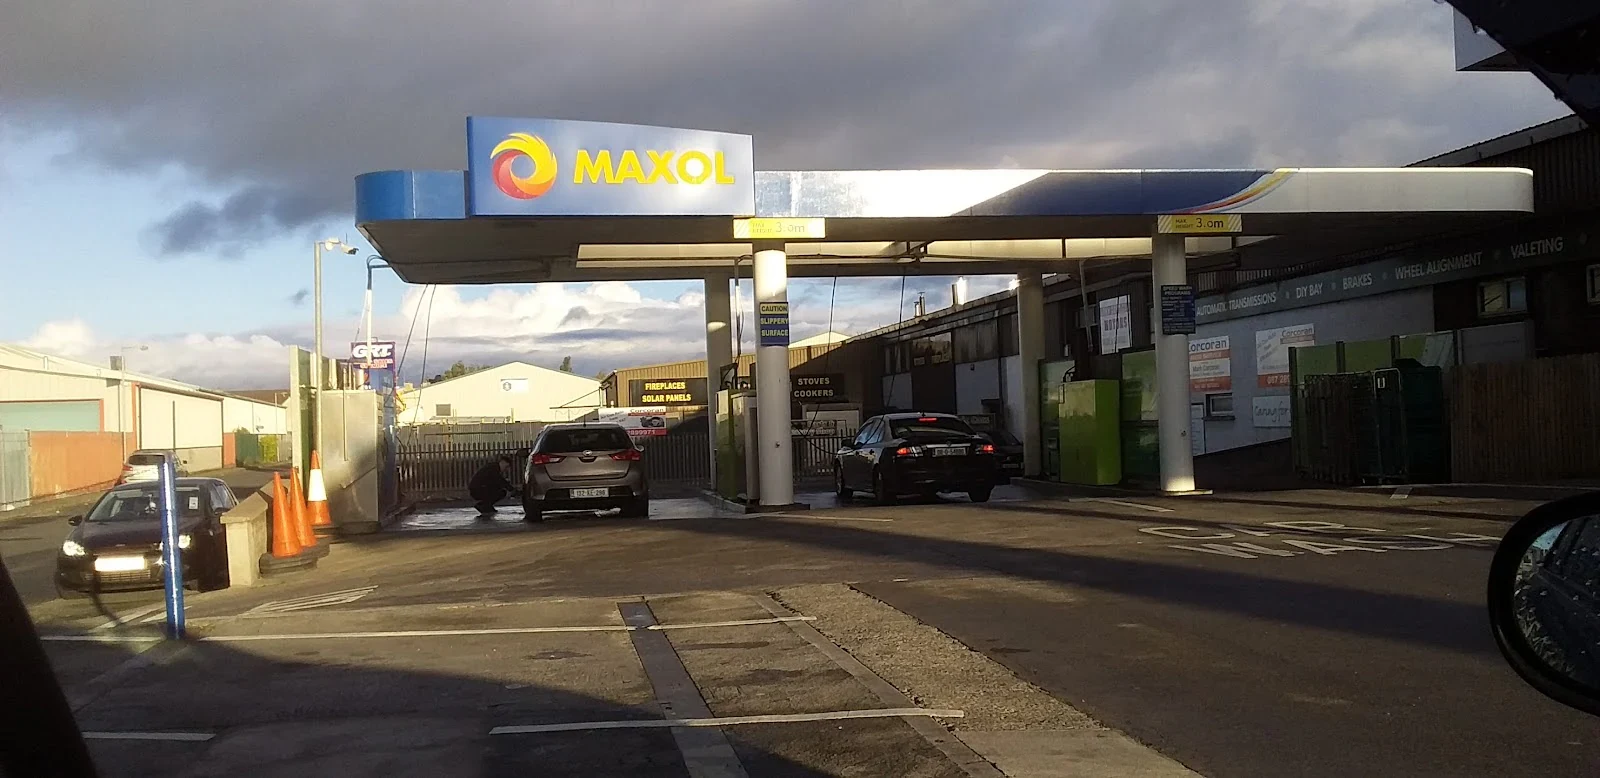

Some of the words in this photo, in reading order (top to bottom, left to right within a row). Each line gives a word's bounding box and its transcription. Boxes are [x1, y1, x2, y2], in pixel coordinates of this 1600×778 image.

[573, 149, 736, 184] MAXOL
[1228, 291, 1277, 310] TRANSMISSIONS
[1296, 285, 1308, 299] DIY
[1309, 283, 1323, 296] BAY
[1342, 273, 1373, 290] BRAKES
[1394, 264, 1425, 280] WHEEL
[1425, 251, 1483, 275] ALIGNMENT
[1510, 236, 1564, 259] VALETING
[761, 317, 788, 325] SLIPPERY
[762, 329, 788, 337] SURFACE
[1282, 328, 1313, 338] Corcoran
[1189, 339, 1227, 352] orcoran
[797, 377, 830, 386] STOVES
[644, 382, 686, 391] FIREPLACES
[641, 394, 665, 403] SOLAR
[666, 393, 692, 402] PANELS
[794, 389, 834, 398] COOKERS
